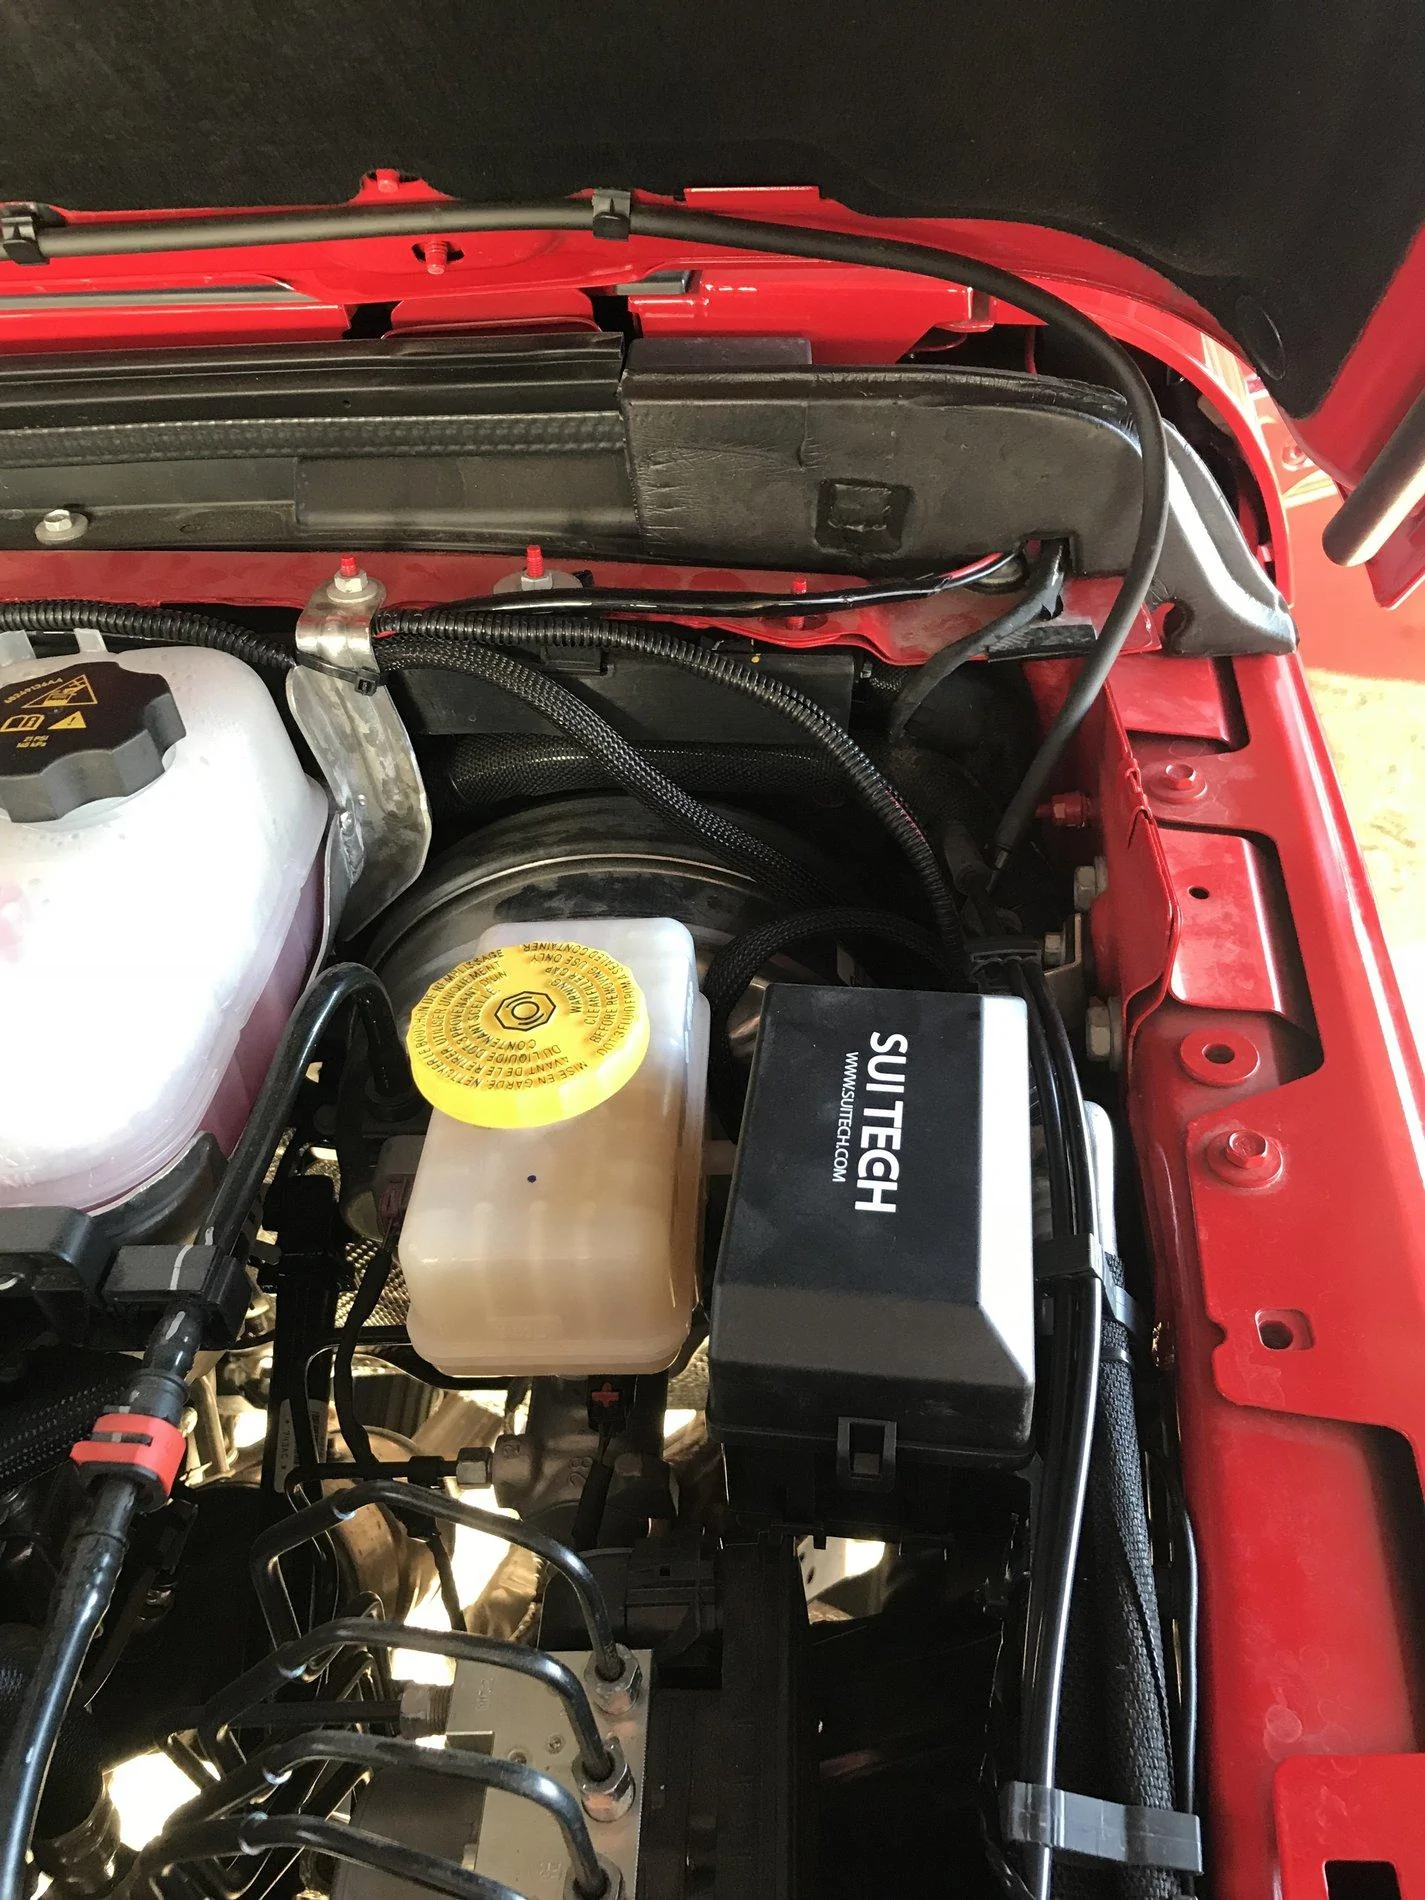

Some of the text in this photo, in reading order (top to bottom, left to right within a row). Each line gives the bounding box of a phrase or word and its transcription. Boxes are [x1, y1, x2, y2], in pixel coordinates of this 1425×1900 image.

[523, 942, 589, 956] CONTAINER
[531, 953, 562, 963] ONLY
[432, 949, 505, 992] REMPLISSAGE
[564, 955, 588, 970] USE
[589, 951, 624, 975] SEALED
[441, 961, 501, 1007] UNIQUEMENT
[620, 981, 635, 1004] FROM
[421, 992, 437, 1007] DE
[545, 966, 601, 1025] CLEAN FILLER CAP
[449, 986, 477, 1038] PROVENANT
[431, 1008, 447, 1047] UTILISER
[589, 1008, 618, 1044] BEFORE
[456, 1036, 468, 1045] 3
[468, 1023, 537, 1050] CONTENANT
[462, 1043, 486, 1059] DOT
[487, 1051, 540, 1064] LIQUIDE
[544, 1044, 561, 1058] DU
[486, 1066, 502, 1077] LE
[506, 1067, 523, 1077] DE
[528, 1056, 569, 1074] AVANT
[560, 1061, 588, 1080] MISE
[537, 1074, 555, 1085] EN
[832, 1051, 859, 1182] WWW.SUITECH.COM
